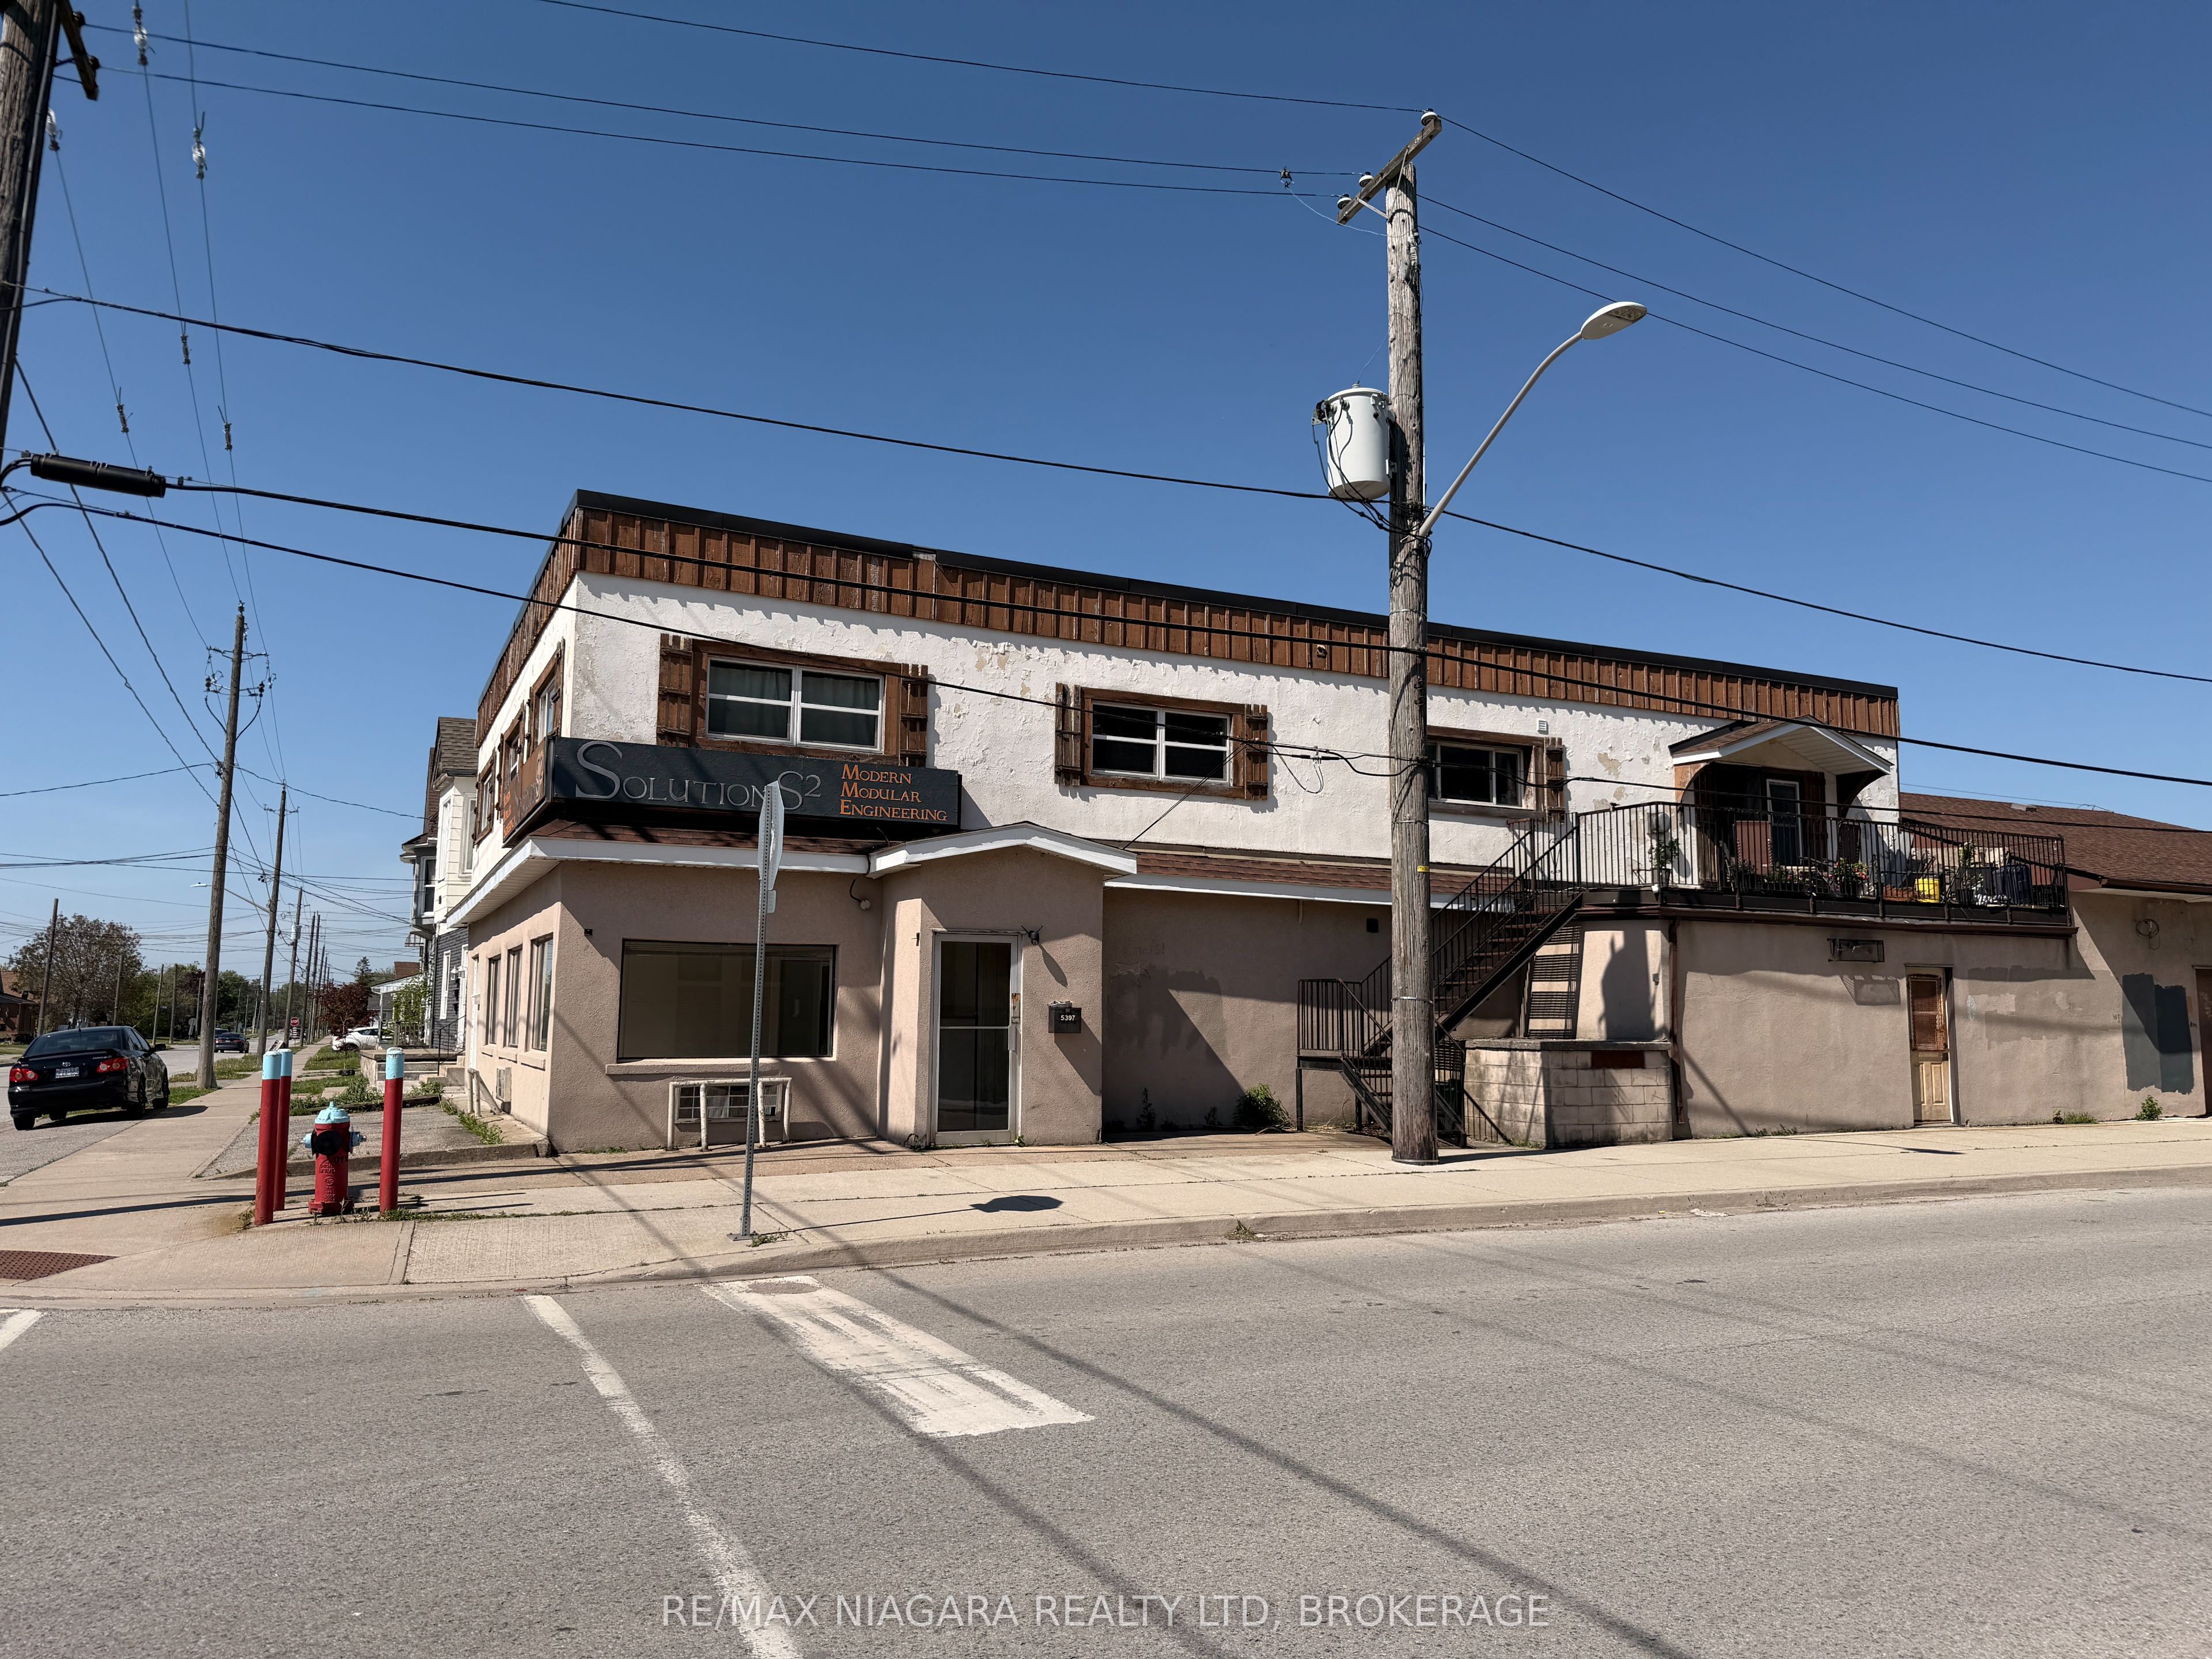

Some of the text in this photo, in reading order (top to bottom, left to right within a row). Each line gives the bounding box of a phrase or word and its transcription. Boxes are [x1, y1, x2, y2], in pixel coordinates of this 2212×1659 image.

[841, 764, 912, 784] MODERN
[840, 781, 922, 802] MODULAR
[839, 799, 948, 821] ENGINEERING
